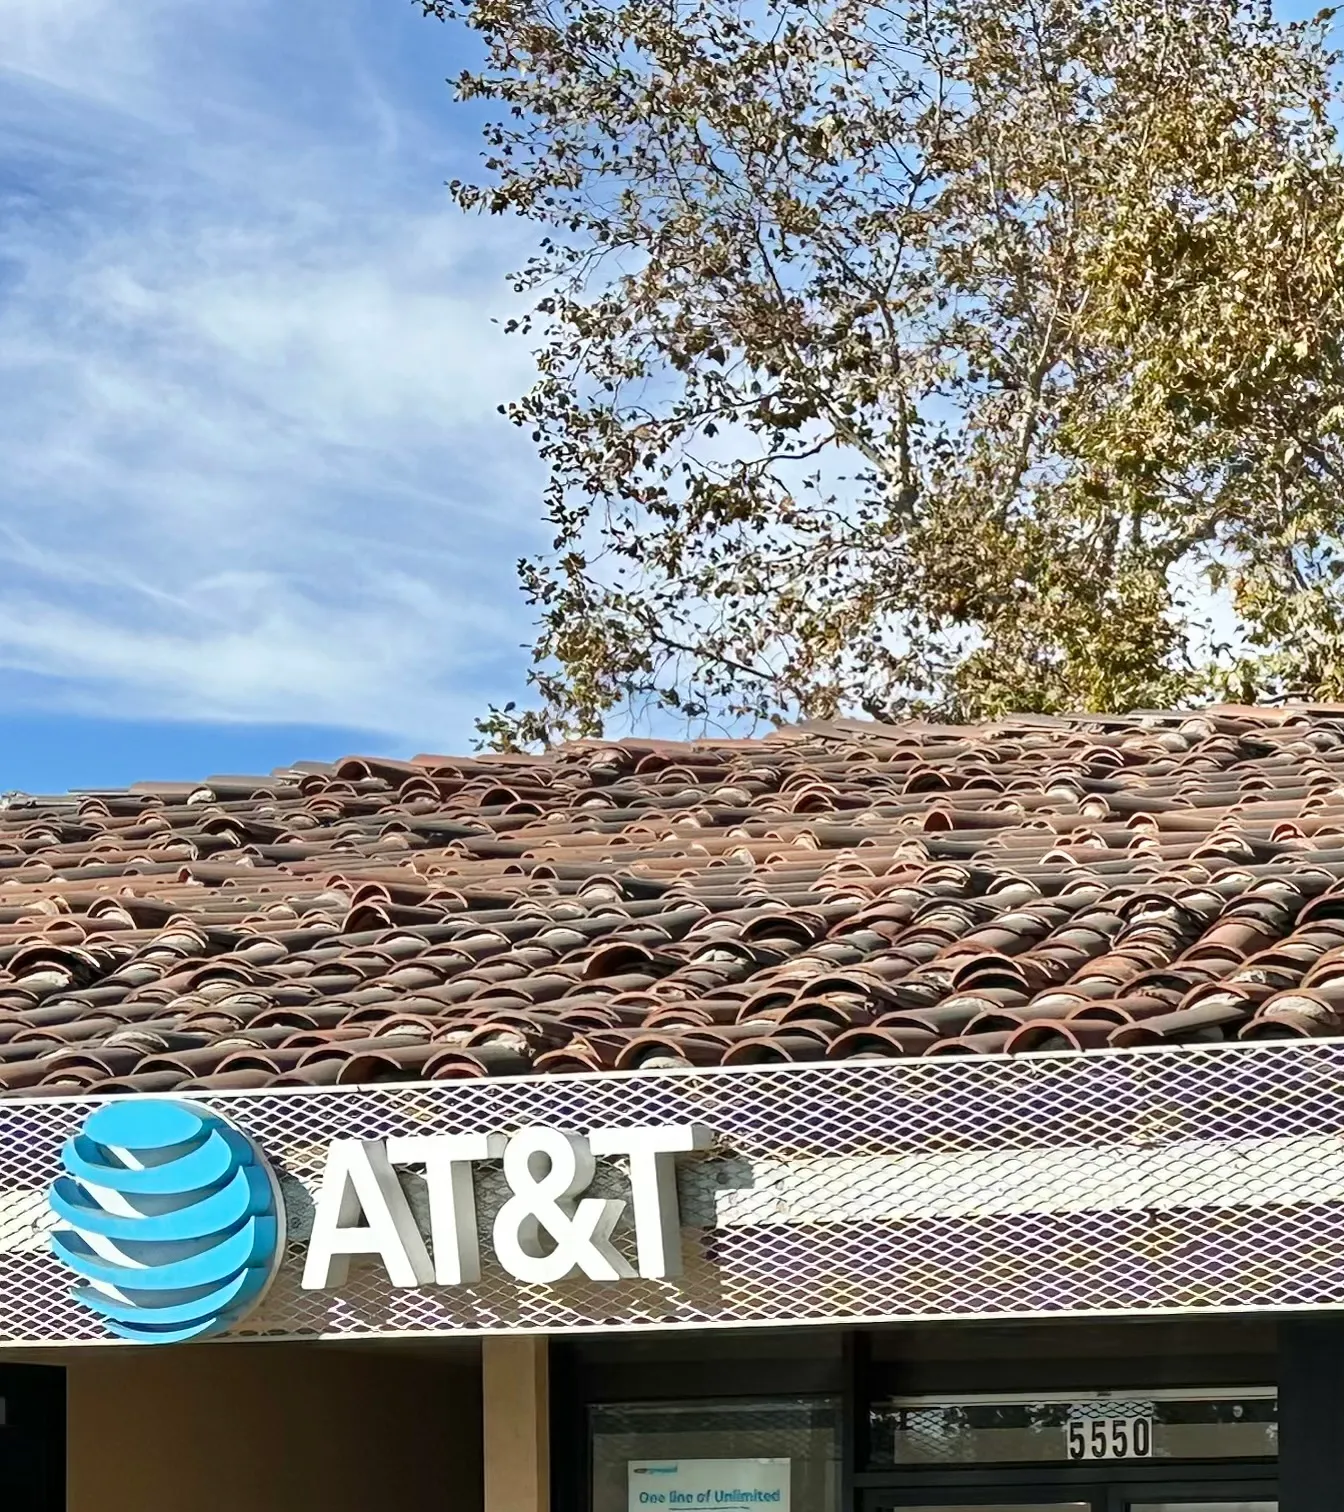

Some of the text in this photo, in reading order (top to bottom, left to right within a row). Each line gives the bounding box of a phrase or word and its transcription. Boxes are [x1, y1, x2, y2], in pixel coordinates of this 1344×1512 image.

[300, 1125, 702, 1291] AT&T
[1069, 1417, 1150, 1460] 5550
[639, 1491, 666, 1503] One
[697, 1489, 711, 1503] of
[714, 1488, 781, 1502] Unlimited
